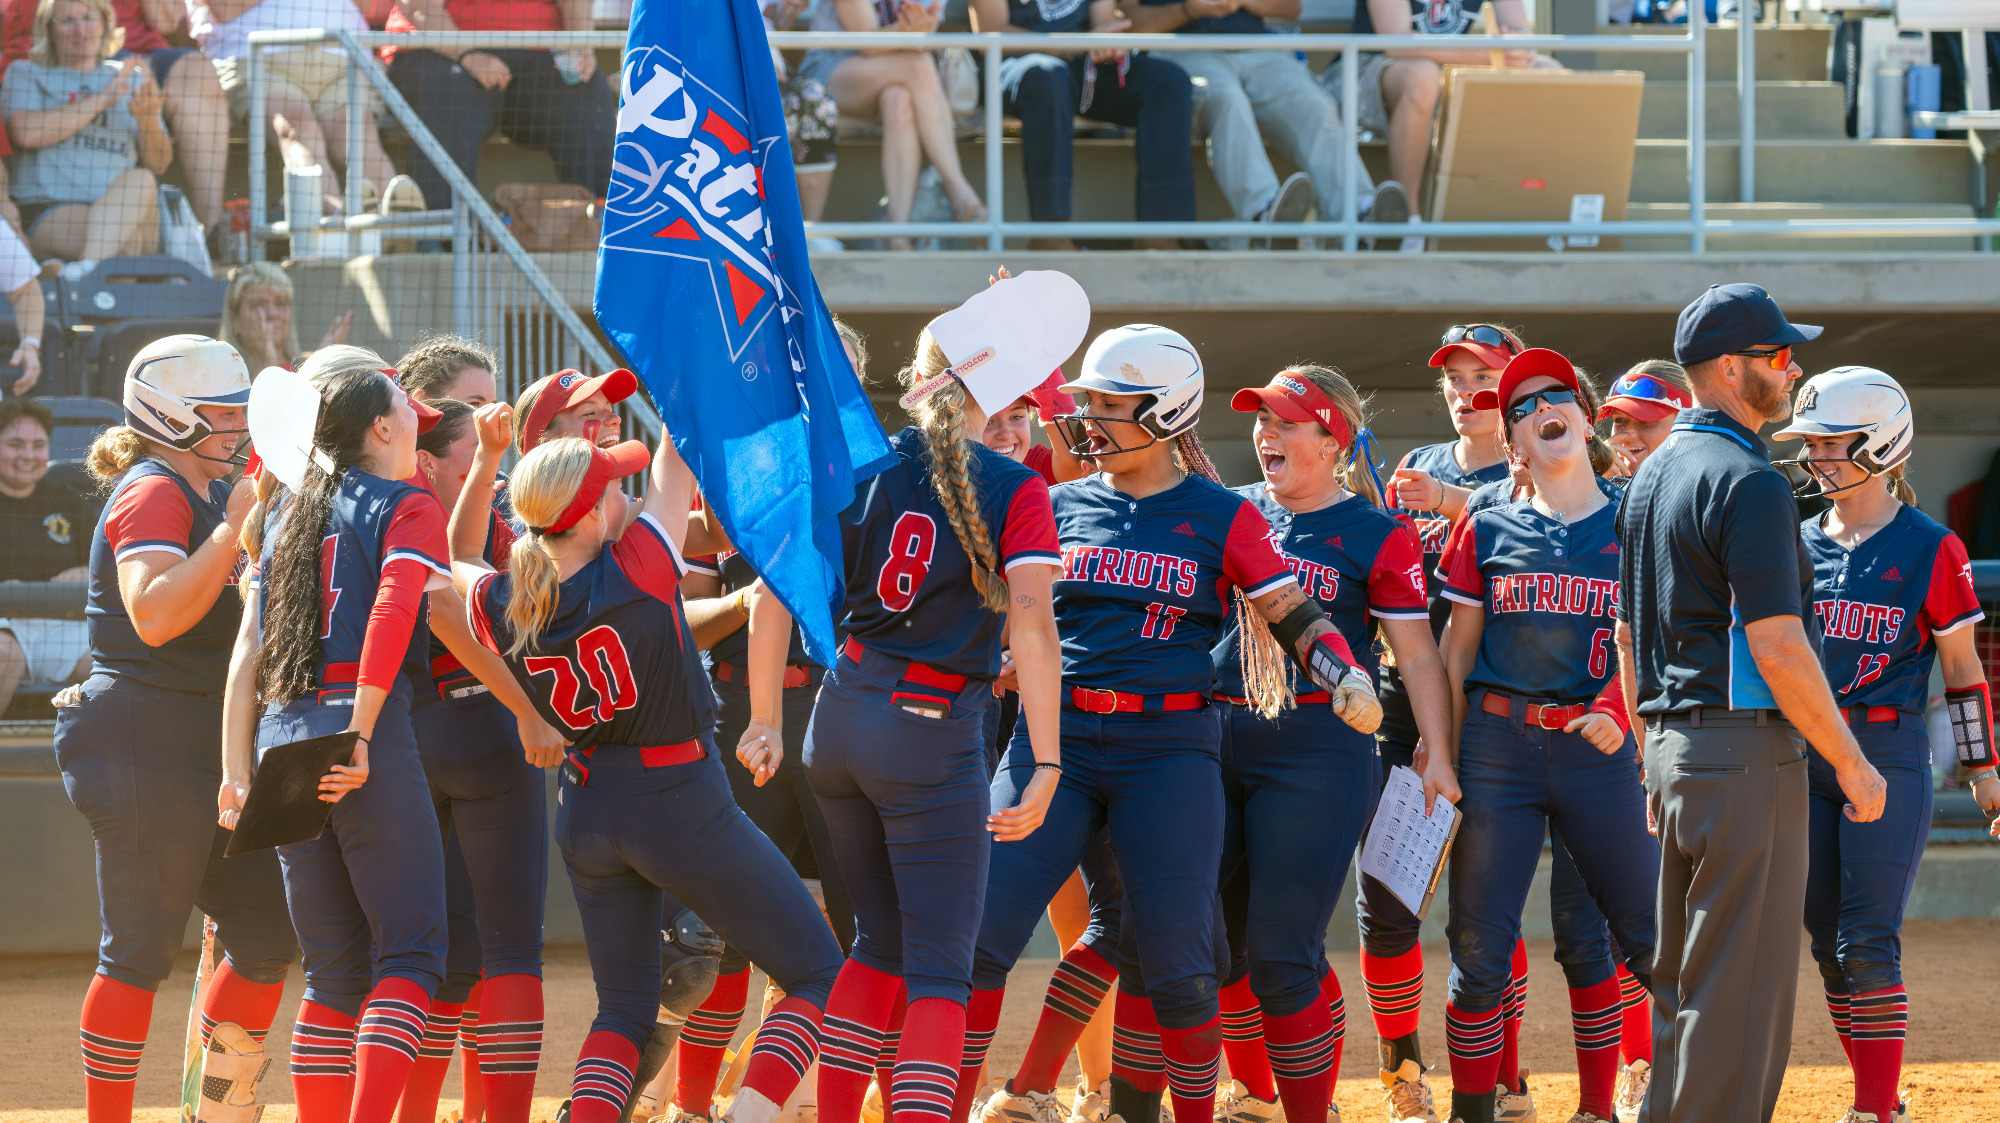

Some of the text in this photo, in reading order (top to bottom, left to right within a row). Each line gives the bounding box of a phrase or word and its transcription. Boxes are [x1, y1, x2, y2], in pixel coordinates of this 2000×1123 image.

[877, 511, 936, 612] 8
[1058, 545, 1198, 597] ATRIOTS
[1141, 602, 1187, 640] 17
[523, 624, 638, 731] 20
[1588, 628, 1612, 679] 6
